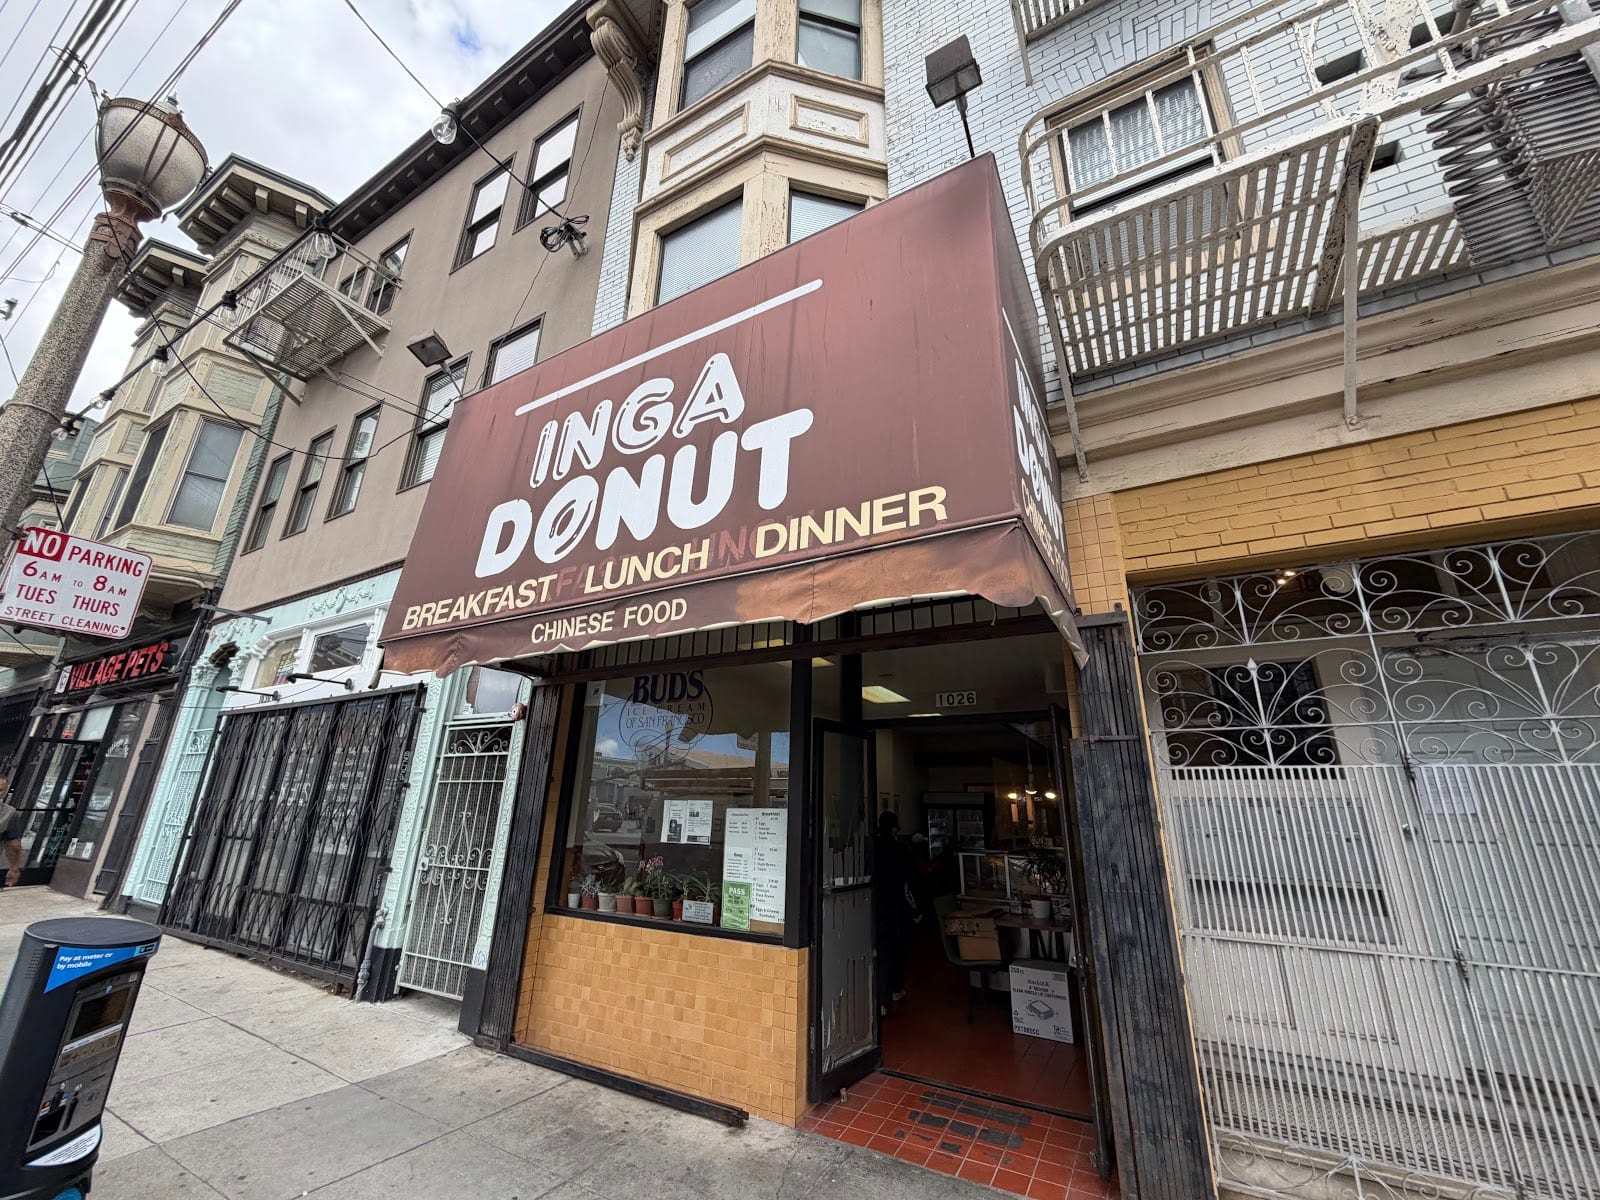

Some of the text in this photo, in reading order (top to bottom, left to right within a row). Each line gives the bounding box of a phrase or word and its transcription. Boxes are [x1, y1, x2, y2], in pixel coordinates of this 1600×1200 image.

[529, 353, 747, 489] INGA
[474, 408, 815, 579] DONUT
[1013, 404, 1065, 553] DONUT
[24, 530, 145, 577] NO PARKING
[401, 574, 559, 632] BREAKFAST
[582, 537, 710, 594] LUNCH
[755, 484, 949, 559] DINNER
[73, 580, 84, 588] TO
[15, 583, 121, 617] TUES THURS
[4, 606, 119, 634] STREET CLEANING
[531, 598, 688, 645] CHINESE FOOD
[69, 653, 126, 691] VILLAGE
[121, 642, 169, 679] PETS
[656, 702, 706, 714] CREAM
[938, 693, 975, 706] 1026
[638, 717, 656, 729] SAN
[728, 887, 745, 896] PASS
[56, 961, 93, 971] by mobile
[58, 955, 72, 963] Pay
[82, 953, 104, 961] meter
